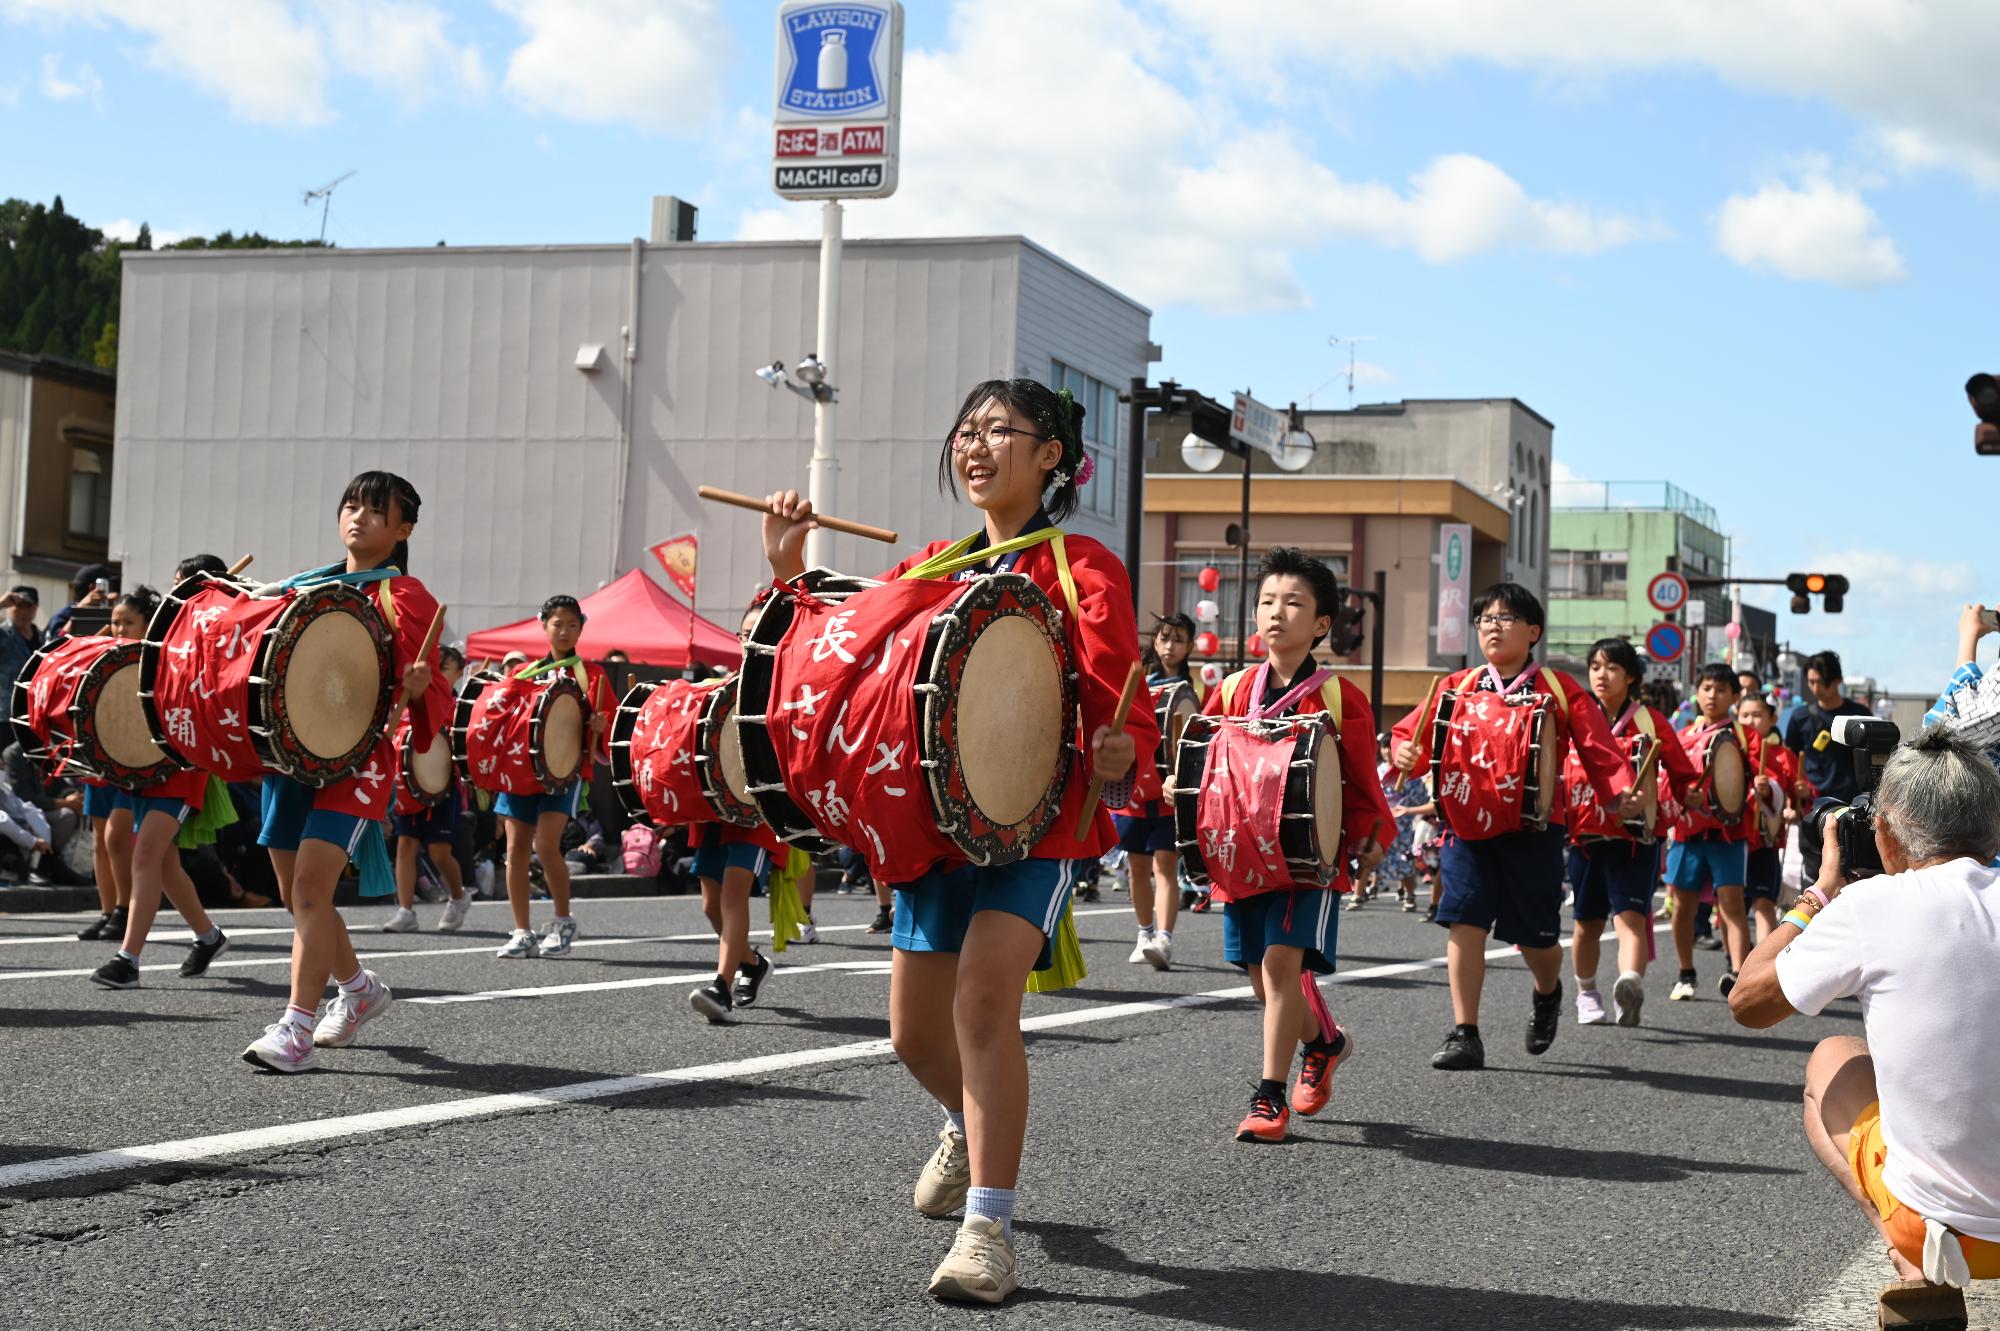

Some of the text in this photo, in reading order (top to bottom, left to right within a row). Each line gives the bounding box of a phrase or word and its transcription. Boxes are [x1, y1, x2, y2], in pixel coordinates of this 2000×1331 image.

[792, 10, 877, 33] LAWSON
[790, 86, 872, 108] STATION
[778, 132, 816, 152] たばこ
[843, 130, 880, 150] ATM
[779, 167, 878, 187] MACHI café
[1656, 583, 1680, 602] 40
